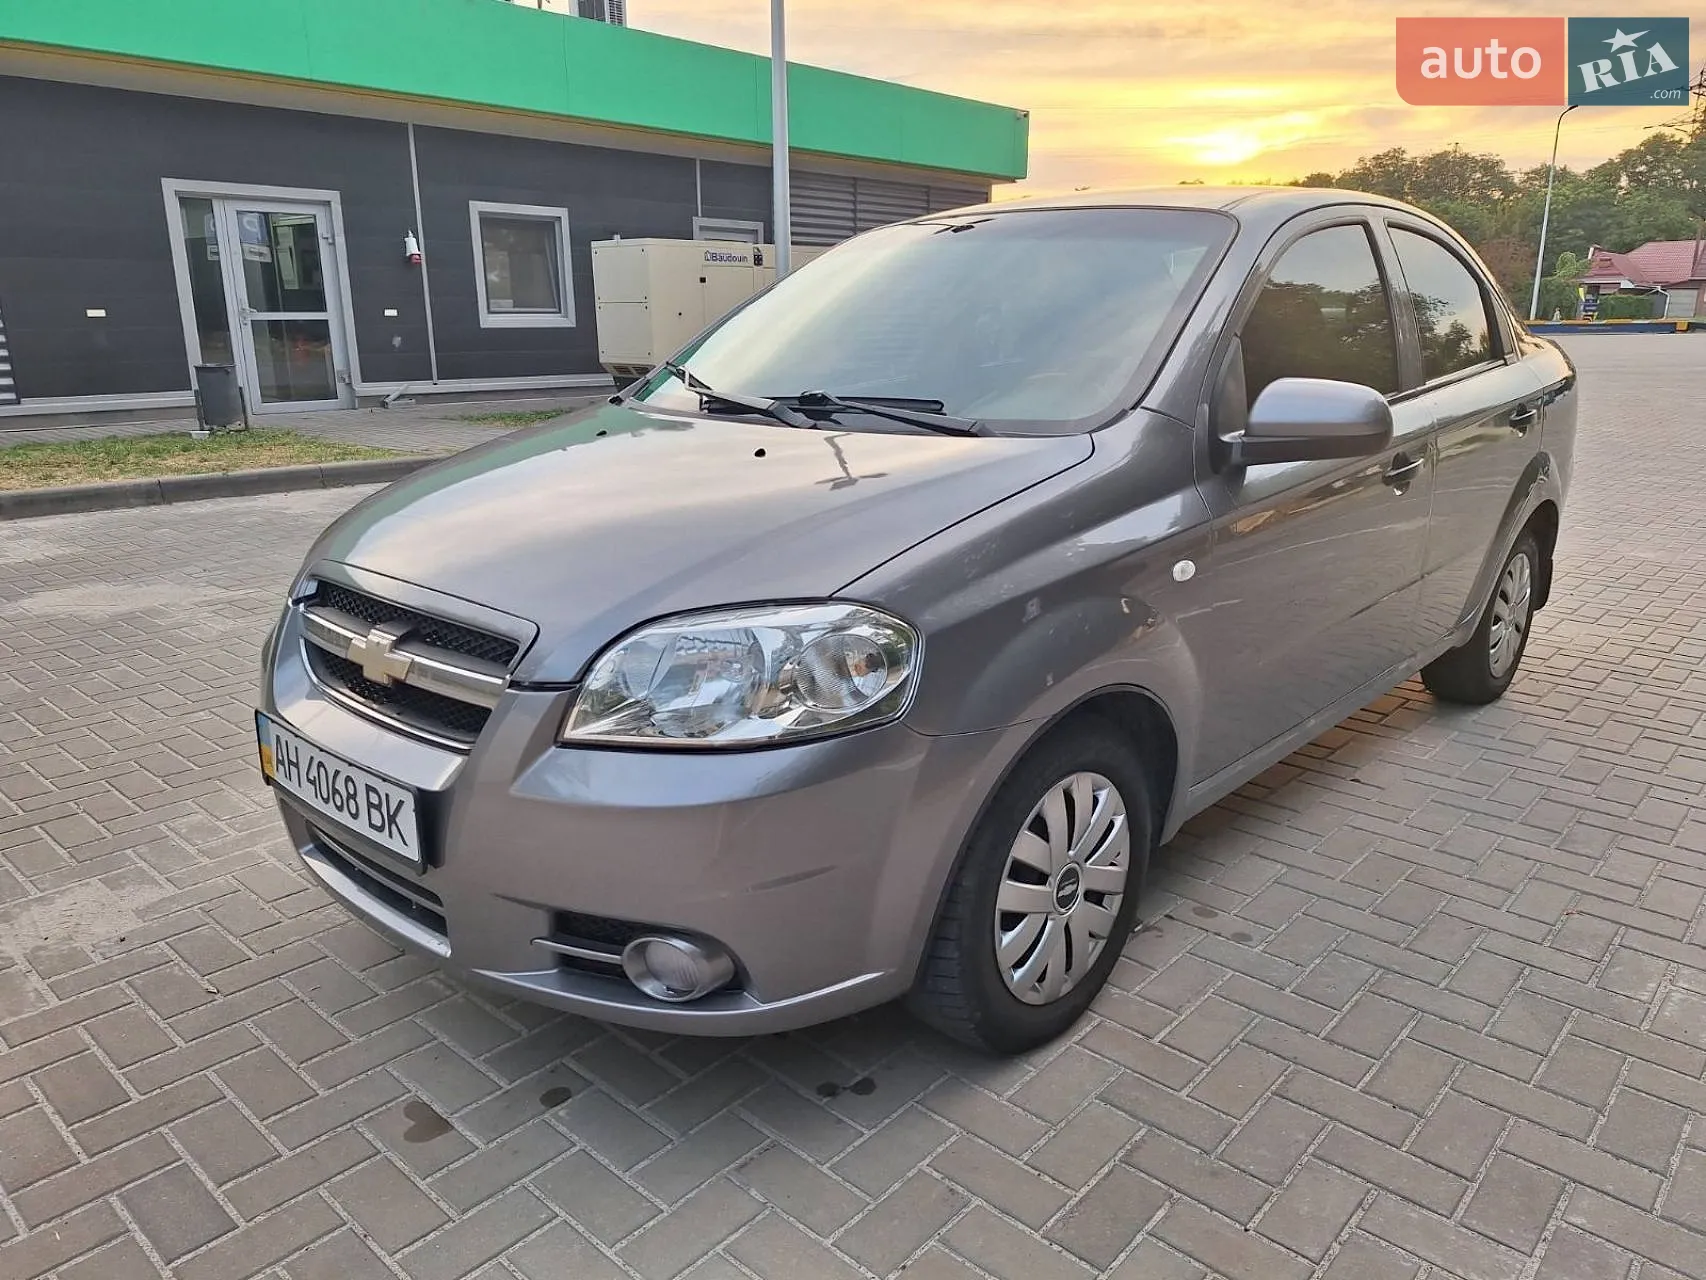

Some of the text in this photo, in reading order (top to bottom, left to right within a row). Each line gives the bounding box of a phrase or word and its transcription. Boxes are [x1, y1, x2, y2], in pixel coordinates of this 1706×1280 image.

[711, 252, 748, 263] Baudouin
[275, 734, 409, 847] AH 4068 BK
